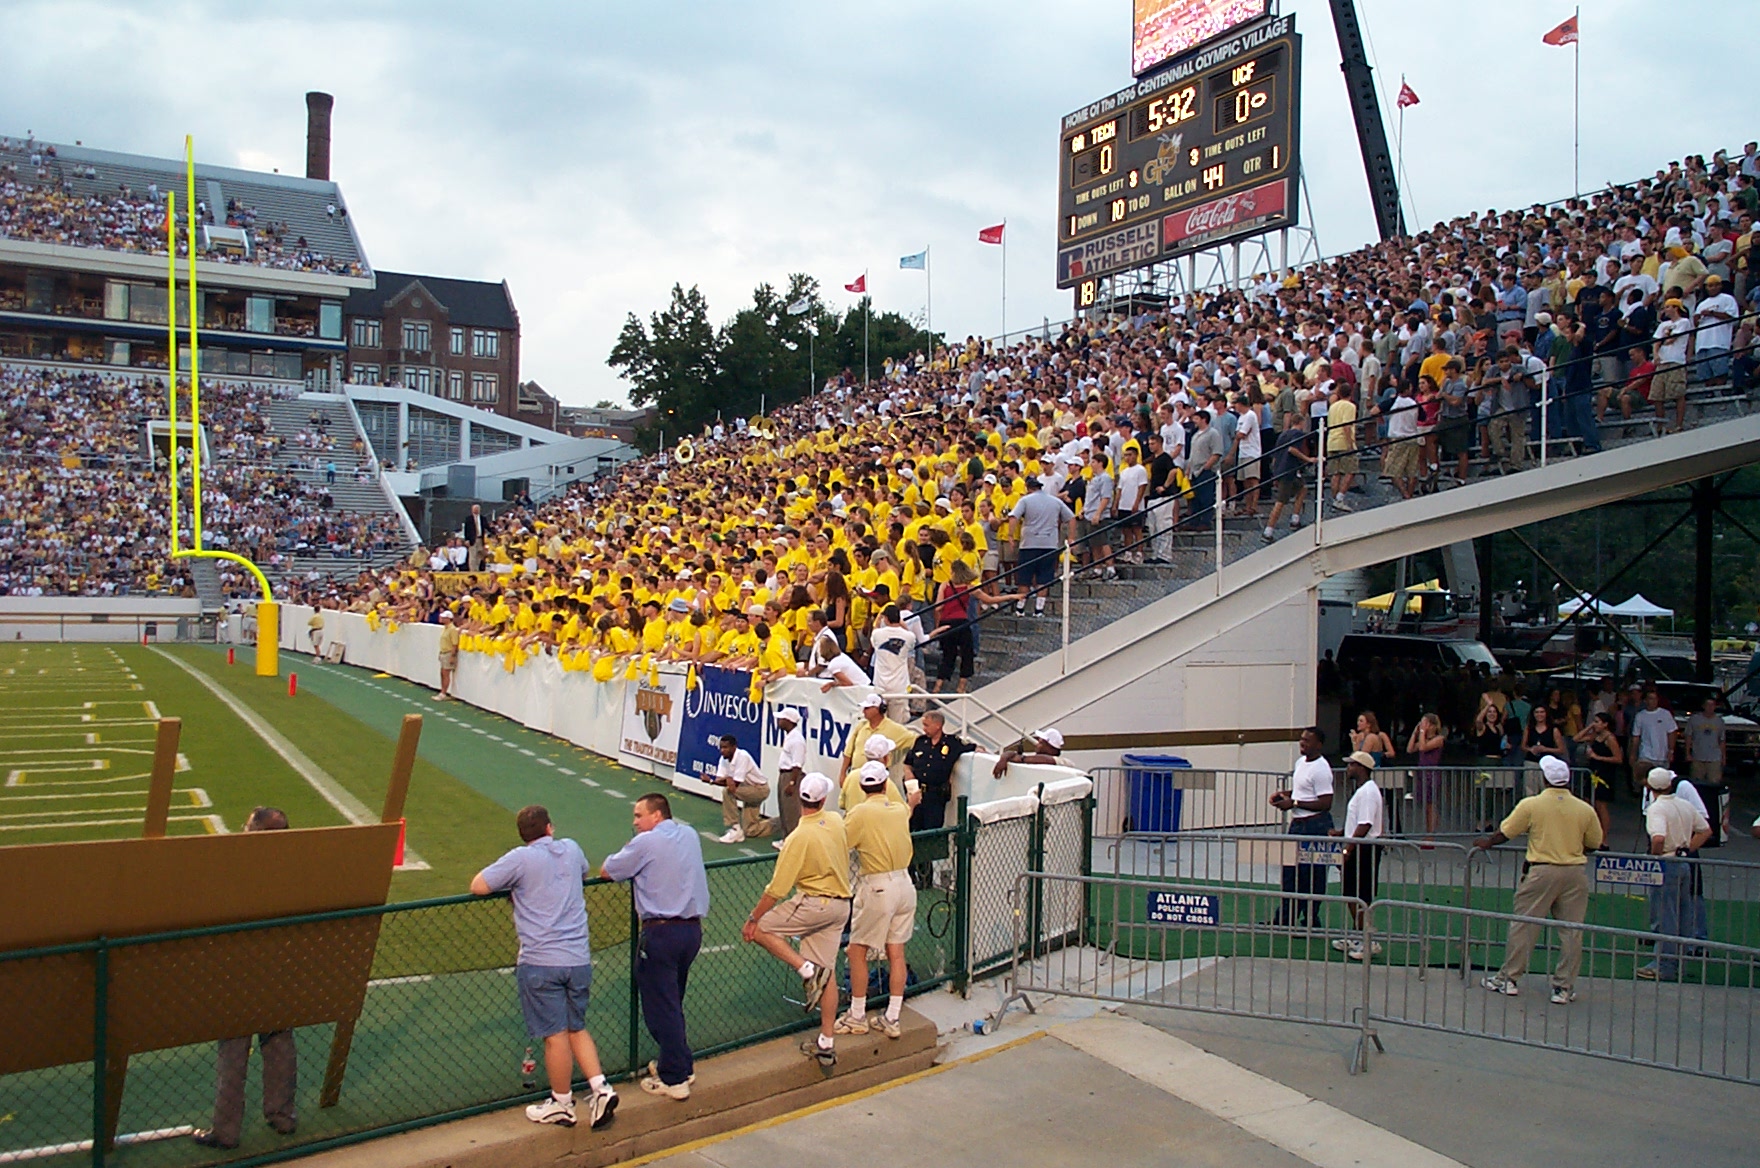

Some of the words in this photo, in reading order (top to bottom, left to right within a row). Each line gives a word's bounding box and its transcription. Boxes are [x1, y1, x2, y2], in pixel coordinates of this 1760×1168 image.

[1065, 107, 1089, 129] HOME
[1101, 98, 1115, 113] The
[1116, 86, 1136, 106] 1996
[1138, 60, 1195, 96] CENTENNIAL
[1195, 40, 1240, 71] OLYMPIC
[1242, 18, 1288, 51] VILLAGE
[1231, 60, 1256, 87] UCF
[1148, 86, 1196, 132] 5:32
[1235, 88, 1250, 123] 0
[1091, 120, 1116, 145] TECH
[1189, 148, 1199, 167] 3
[1205, 142, 1222, 158] TIME
[1225, 134, 1244, 152] OUTS
[1248, 126, 1267, 143] LEFT
[1100, 144, 1112, 175] 0
[1243, 156, 1262, 174] QTR
[1272, 145, 1279, 169] 1
[1075, 190, 1090, 205] TIME
[1091, 184, 1107, 199] OUTS
[1109, 178, 1125, 193] LEFT
[1164, 182, 1183, 201] BALL
[1185, 178, 1197, 195] ON
[1203, 163, 1224, 190] 44
[1070, 215, 1077, 236] 1
[1077, 211, 1098, 230] DOWN
[1111, 198, 1126, 222] 10
[1128, 197, 1138, 213] TO
[1139, 193, 1151, 209] GO
[1085, 224, 1154, 258] RUSSELL
[1085, 241, 1155, 275] ATHLETIC
[703, 690, 759, 724] INVESCO
[766, 701, 852, 759] MT-Rx
[1599, 857, 1662, 872] ATLANTA
[1156, 893, 1209, 907] ATLANTA
[1157, 904, 1185, 913] POLICE
[1190, 907, 1208, 915] LINE
[1151, 912, 1163, 920] DO
[1167, 913, 1182, 921] NOT
[1186, 915, 1214, 924] CROSS
